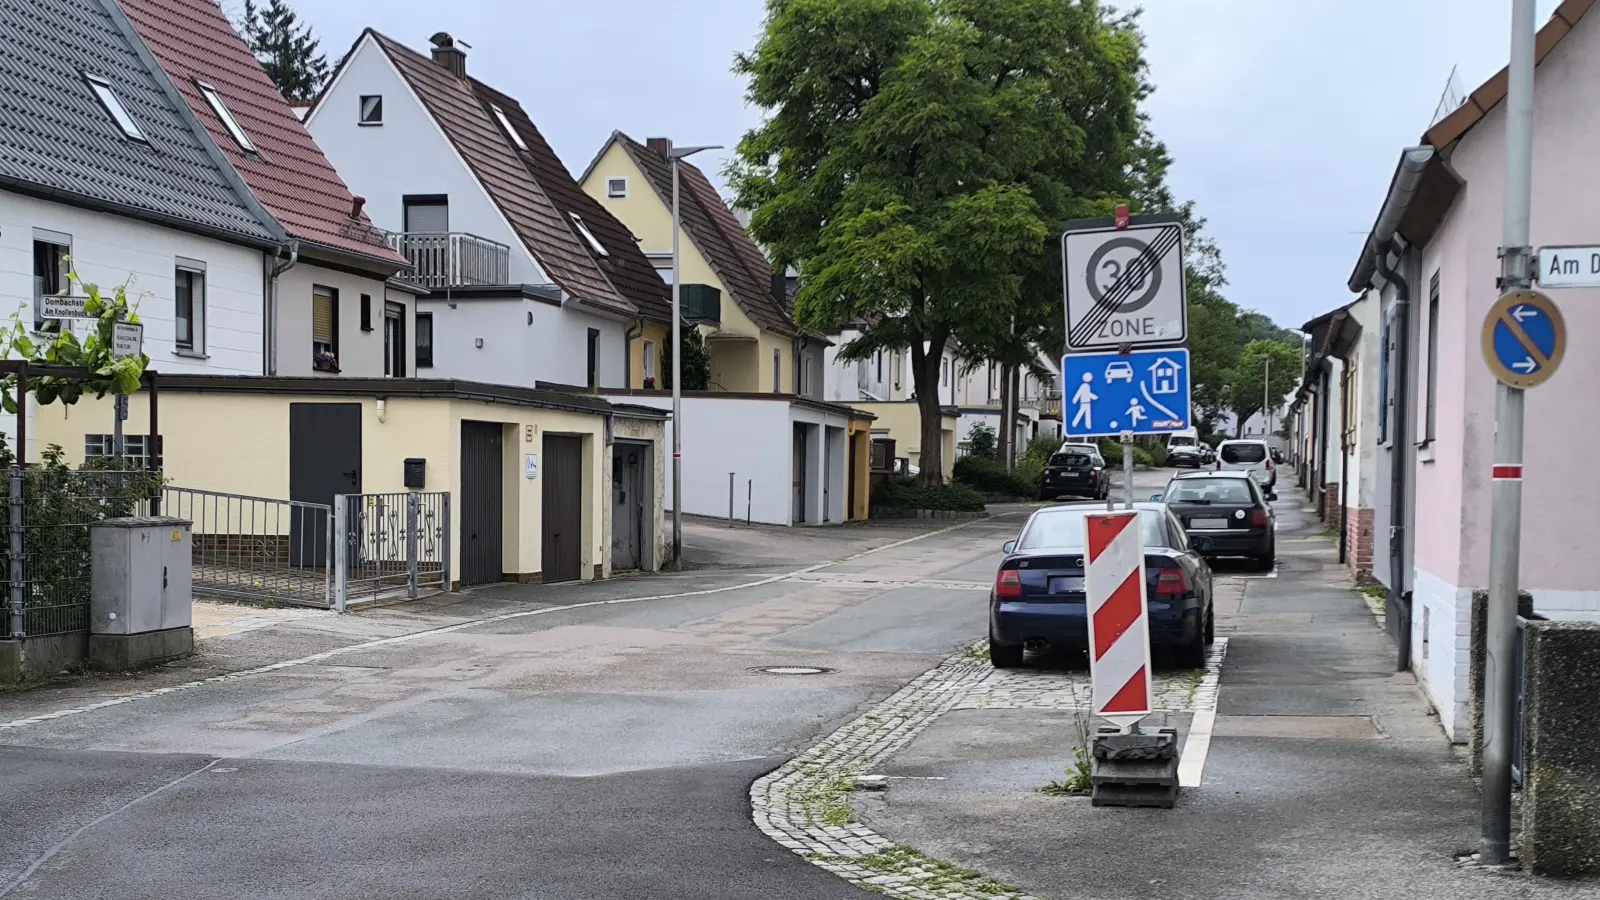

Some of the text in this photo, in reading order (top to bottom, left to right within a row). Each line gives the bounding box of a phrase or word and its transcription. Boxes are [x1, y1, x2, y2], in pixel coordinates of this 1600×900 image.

[1549, 254, 1580, 275] Am
[1102, 257, 1145, 294] 30
[1097, 317, 1155, 338] ZONE
